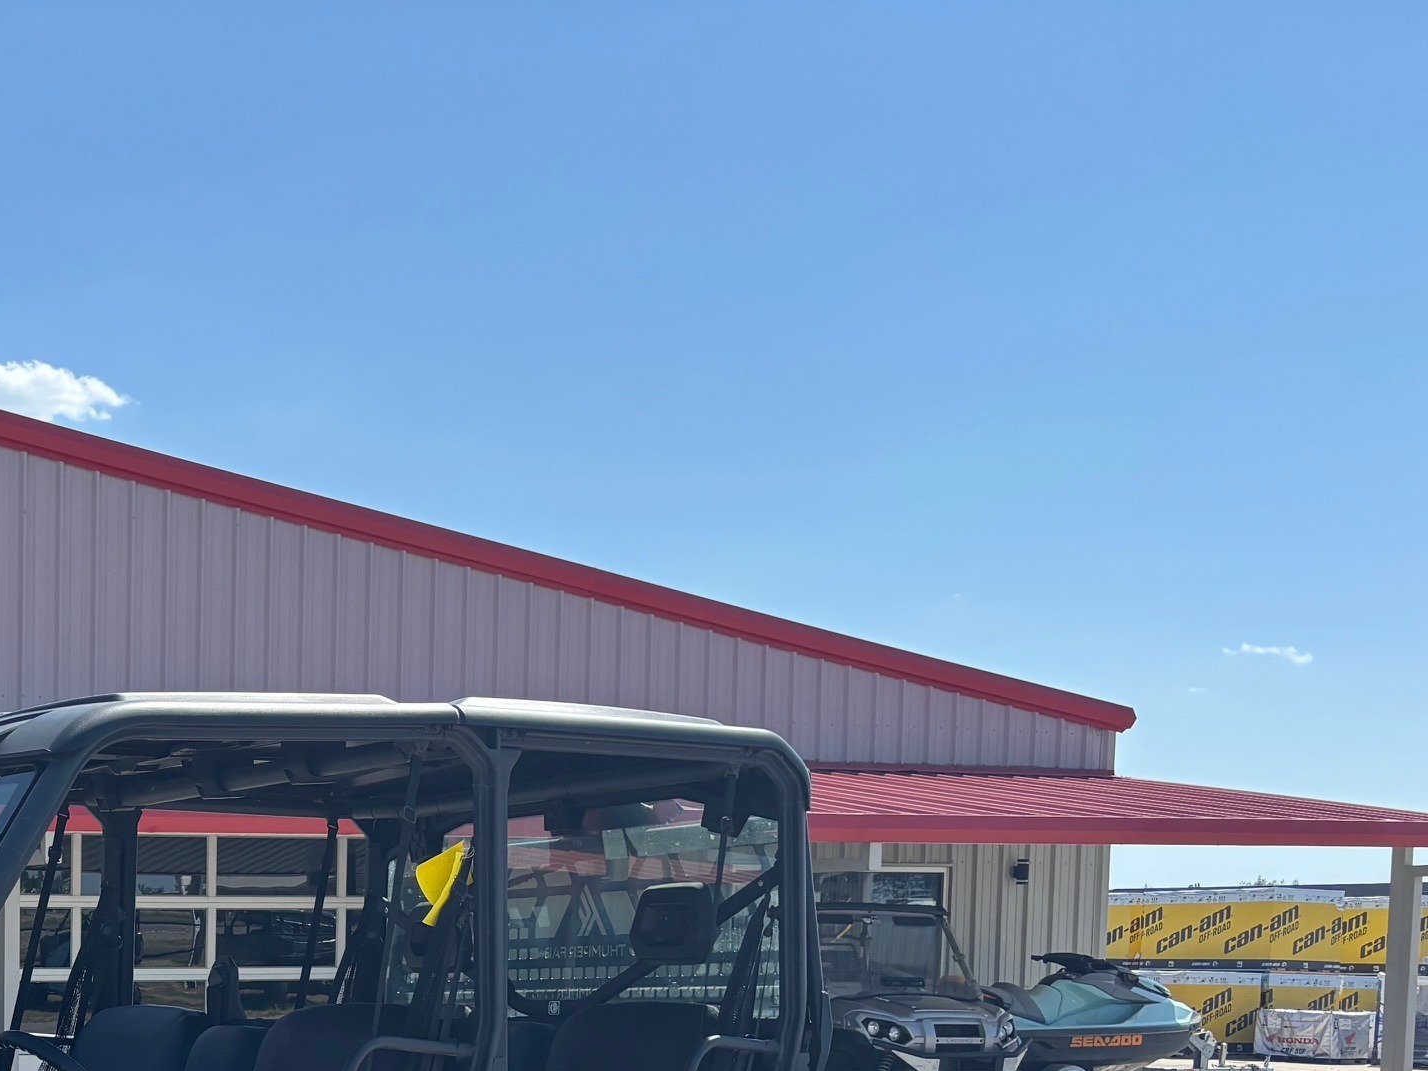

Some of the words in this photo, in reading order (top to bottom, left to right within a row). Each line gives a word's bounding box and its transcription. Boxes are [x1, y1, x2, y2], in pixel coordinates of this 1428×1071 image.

[1157, 905, 1231, 954] can-am
[1199, 921, 1231, 943] OFF-ROAD
[1224, 905, 1299, 954] can-am
[1269, 921, 1299, 943] OFF-ROAD
[1278, 1036, 1320, 1045] HONDA
